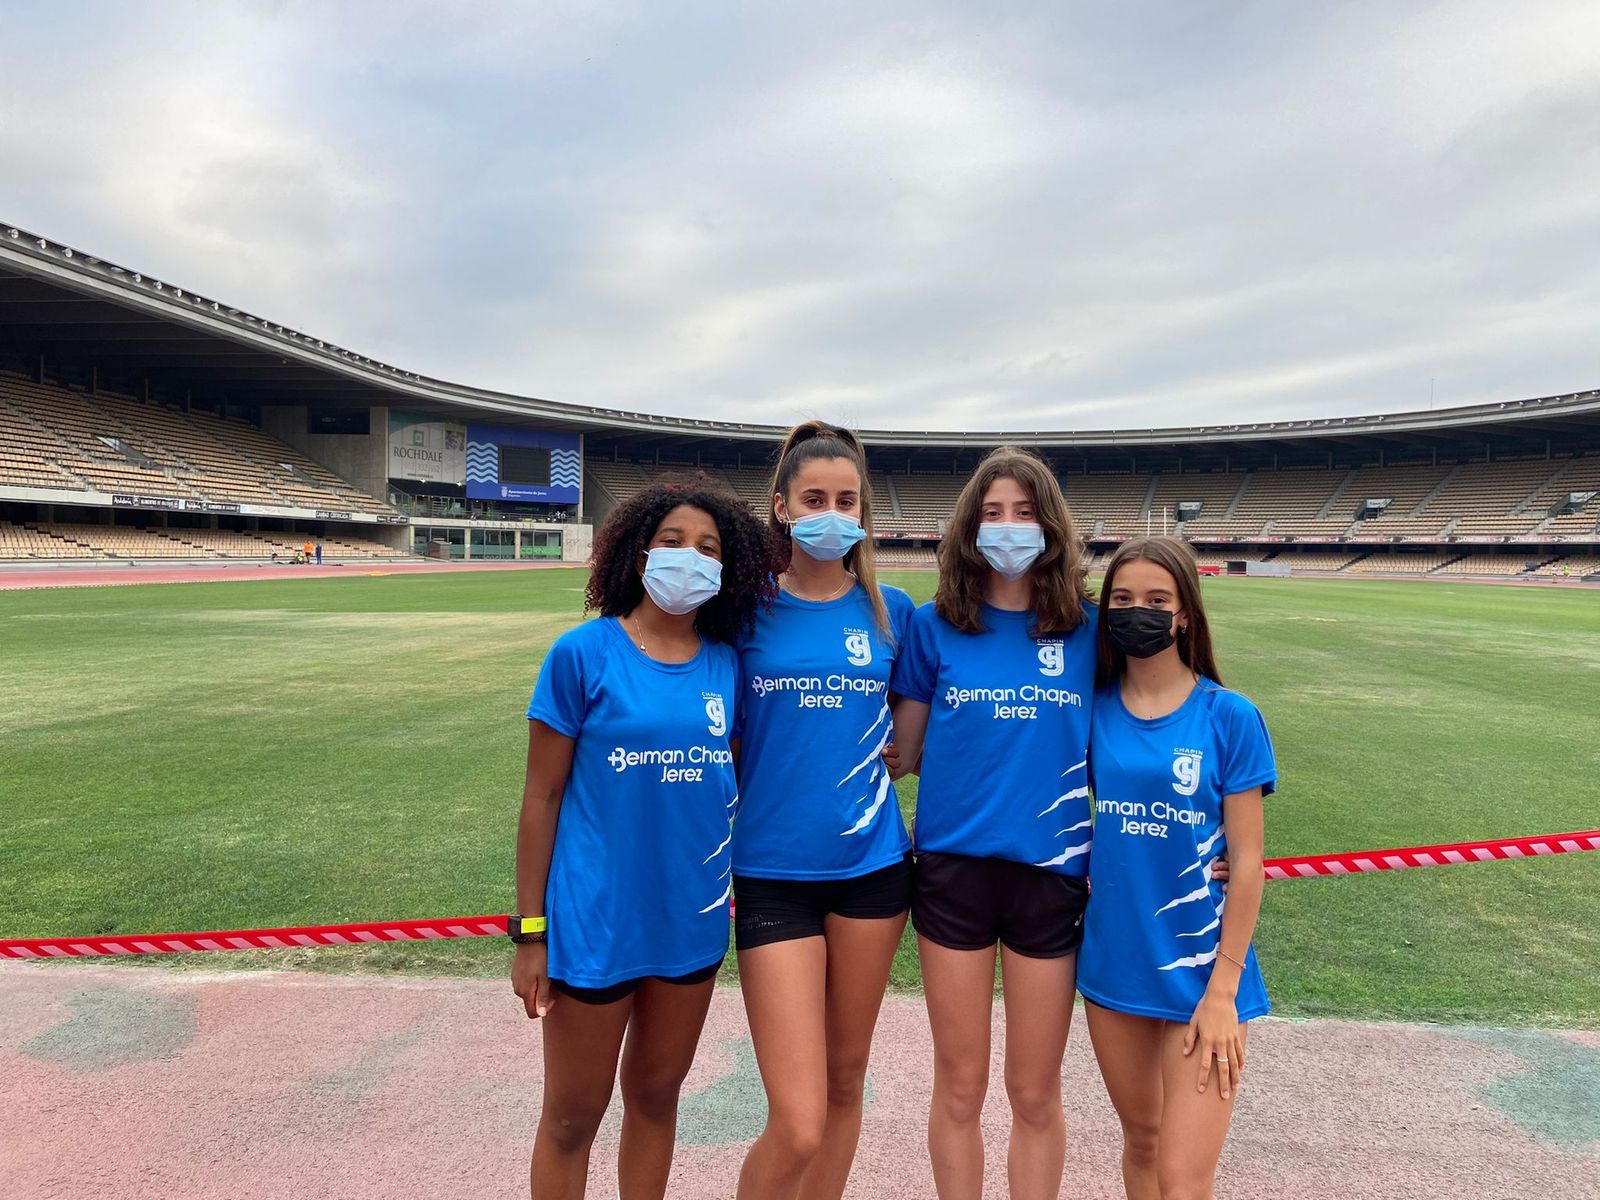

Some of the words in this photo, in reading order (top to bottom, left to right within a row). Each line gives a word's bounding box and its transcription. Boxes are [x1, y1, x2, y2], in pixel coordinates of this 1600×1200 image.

[393, 446, 443, 463] ROCHDALE
[826, 674, 885, 697] Chapin
[798, 692, 843, 708] Jerez
[1019, 685, 1081, 708] Chapin
[993, 703, 1038, 719] Jerez
[688, 746, 733, 768] Chapi
[661, 766, 703, 783] Jerez
[1096, 800, 1146, 817] iman
[1120, 817, 1168, 839] Jerez
